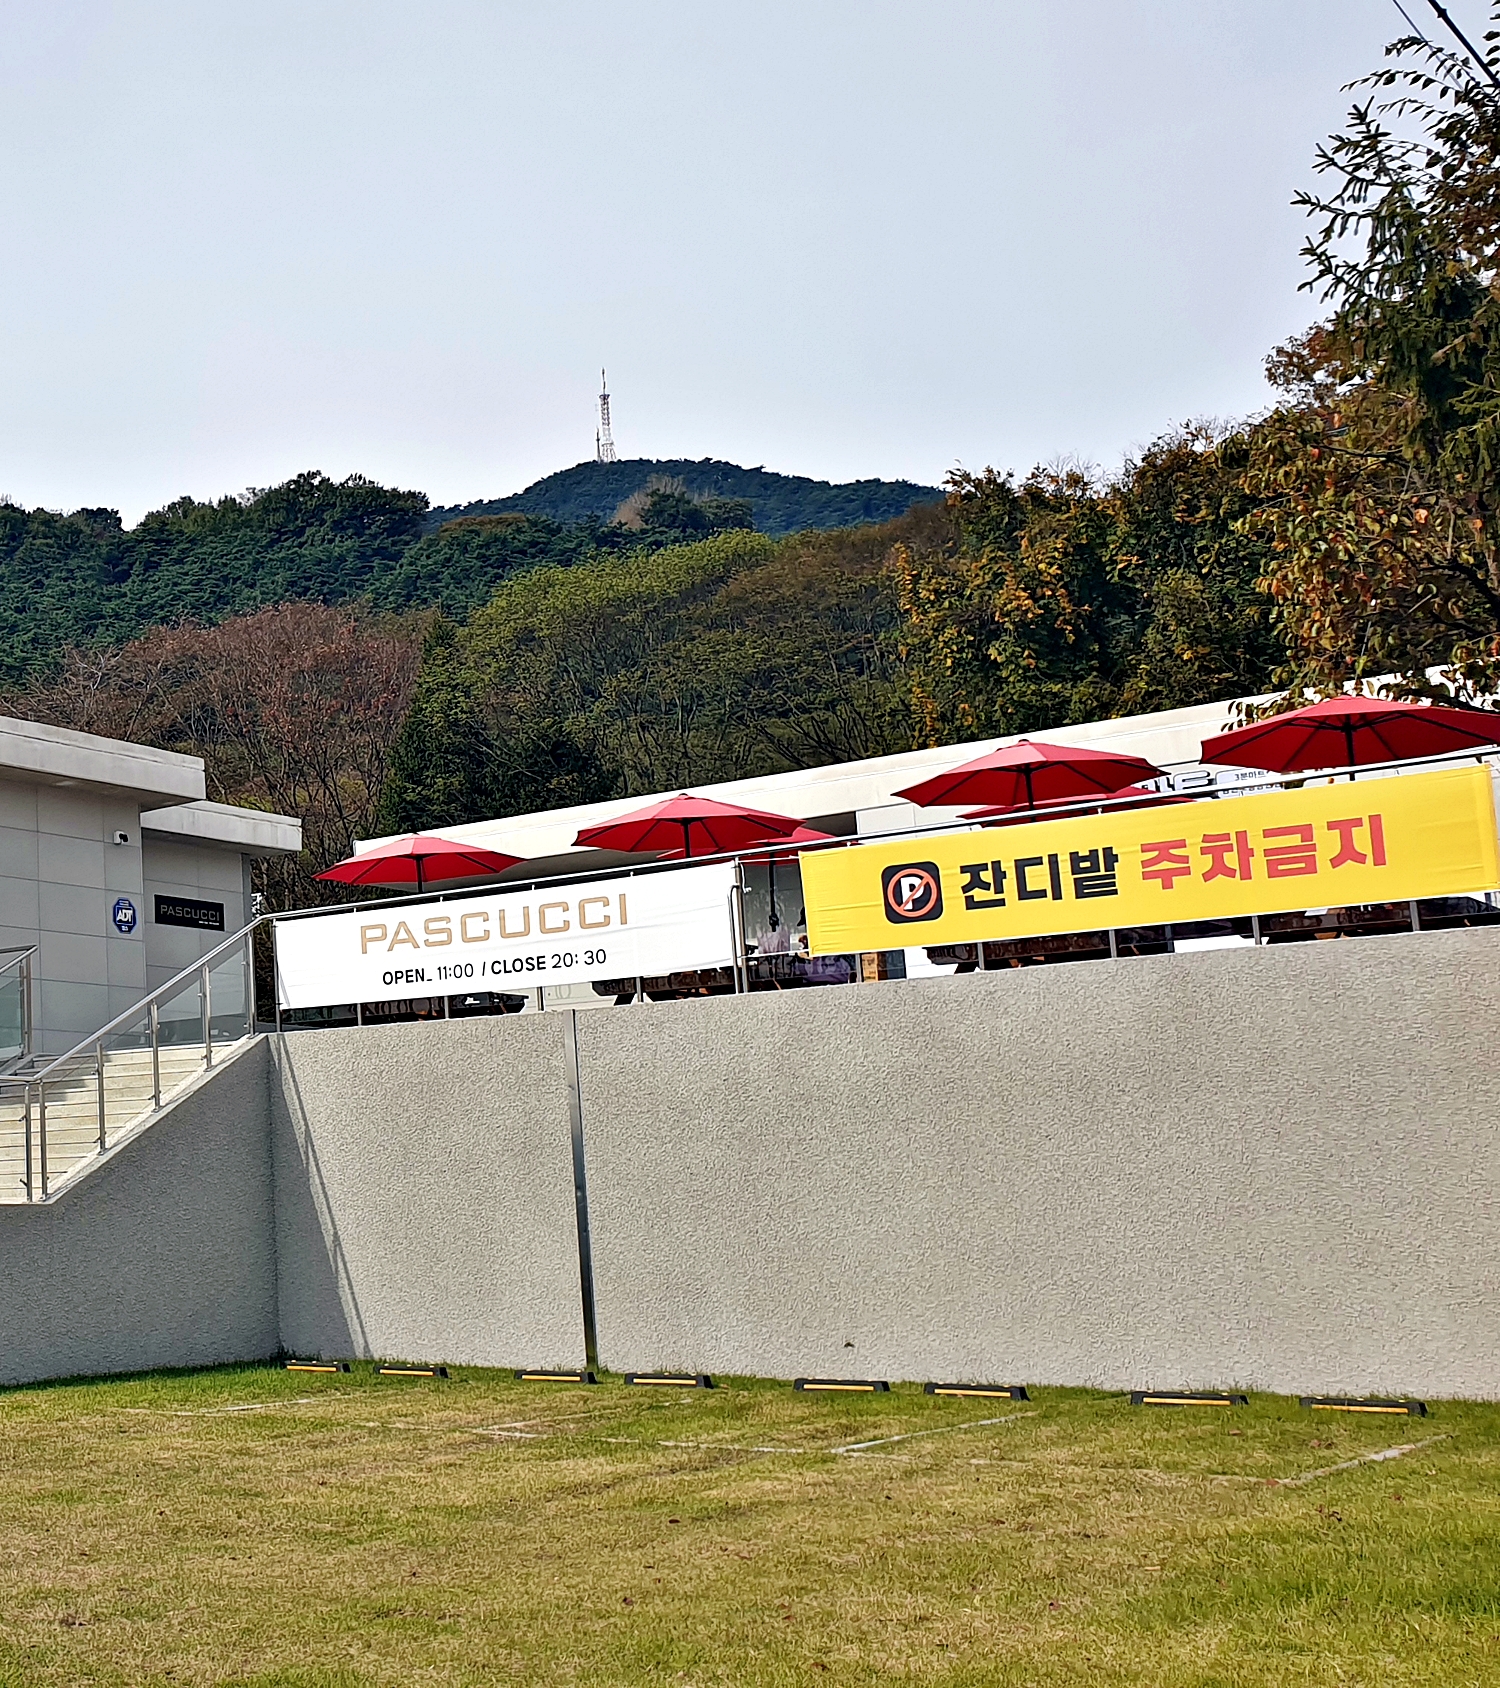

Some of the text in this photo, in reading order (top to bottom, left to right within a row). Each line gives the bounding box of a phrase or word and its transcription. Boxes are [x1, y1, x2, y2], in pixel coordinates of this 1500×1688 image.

[960, 847, 1119, 910] 잔디밭
[1140, 814, 1387, 890] 주차금지
[116, 909, 133, 923] ADT
[160, 905, 220, 921] PASCUCCI
[360, 893, 628, 954] PASCUCCI
[437, 963, 474, 981] 11:00
[490, 955, 546, 976] CLOSE
